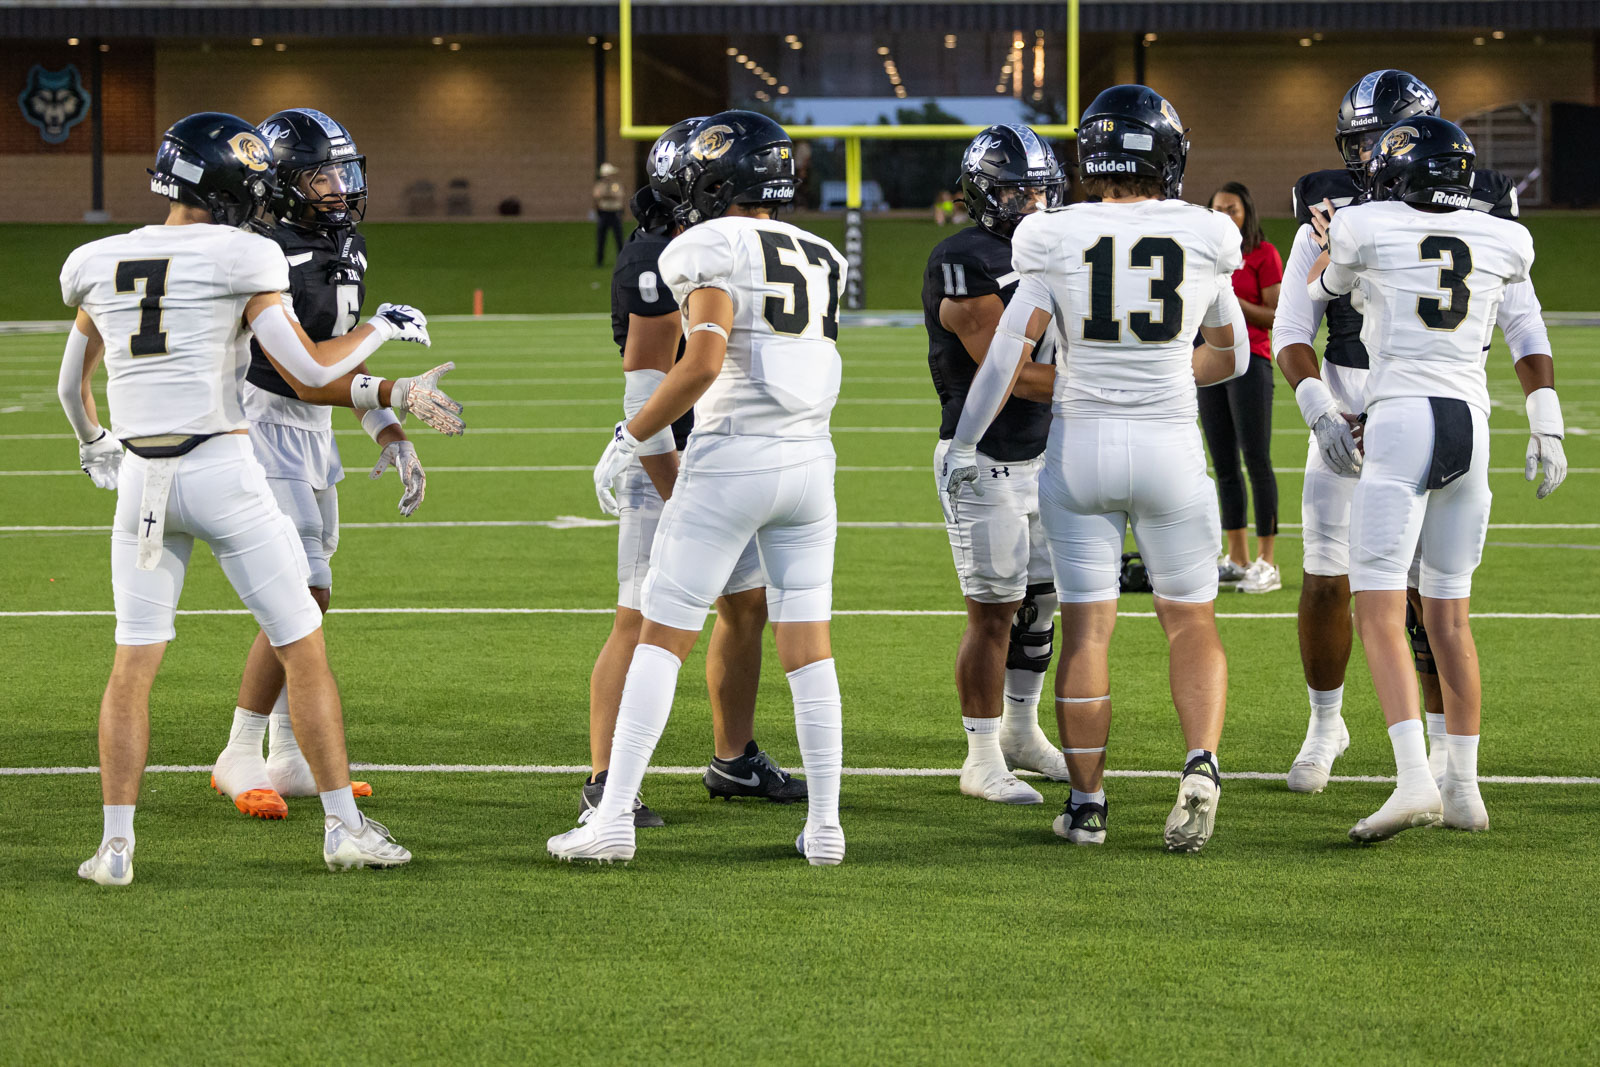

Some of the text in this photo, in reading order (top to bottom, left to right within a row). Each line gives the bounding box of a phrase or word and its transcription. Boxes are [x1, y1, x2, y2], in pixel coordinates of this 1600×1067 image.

[1103, 121, 1114, 132] 13
[1351, 116, 1378, 126] Riddell
[1086, 160, 1136, 173] Riddell
[1461, 159, 1467, 169] 3
[1431, 190, 1471, 208] Riddel
[757, 229, 841, 345] 57
[941, 263, 968, 296] 11
[1082, 234, 1186, 344] 13
[1416, 233, 1474, 332] 3
[114, 256, 173, 358] 7
